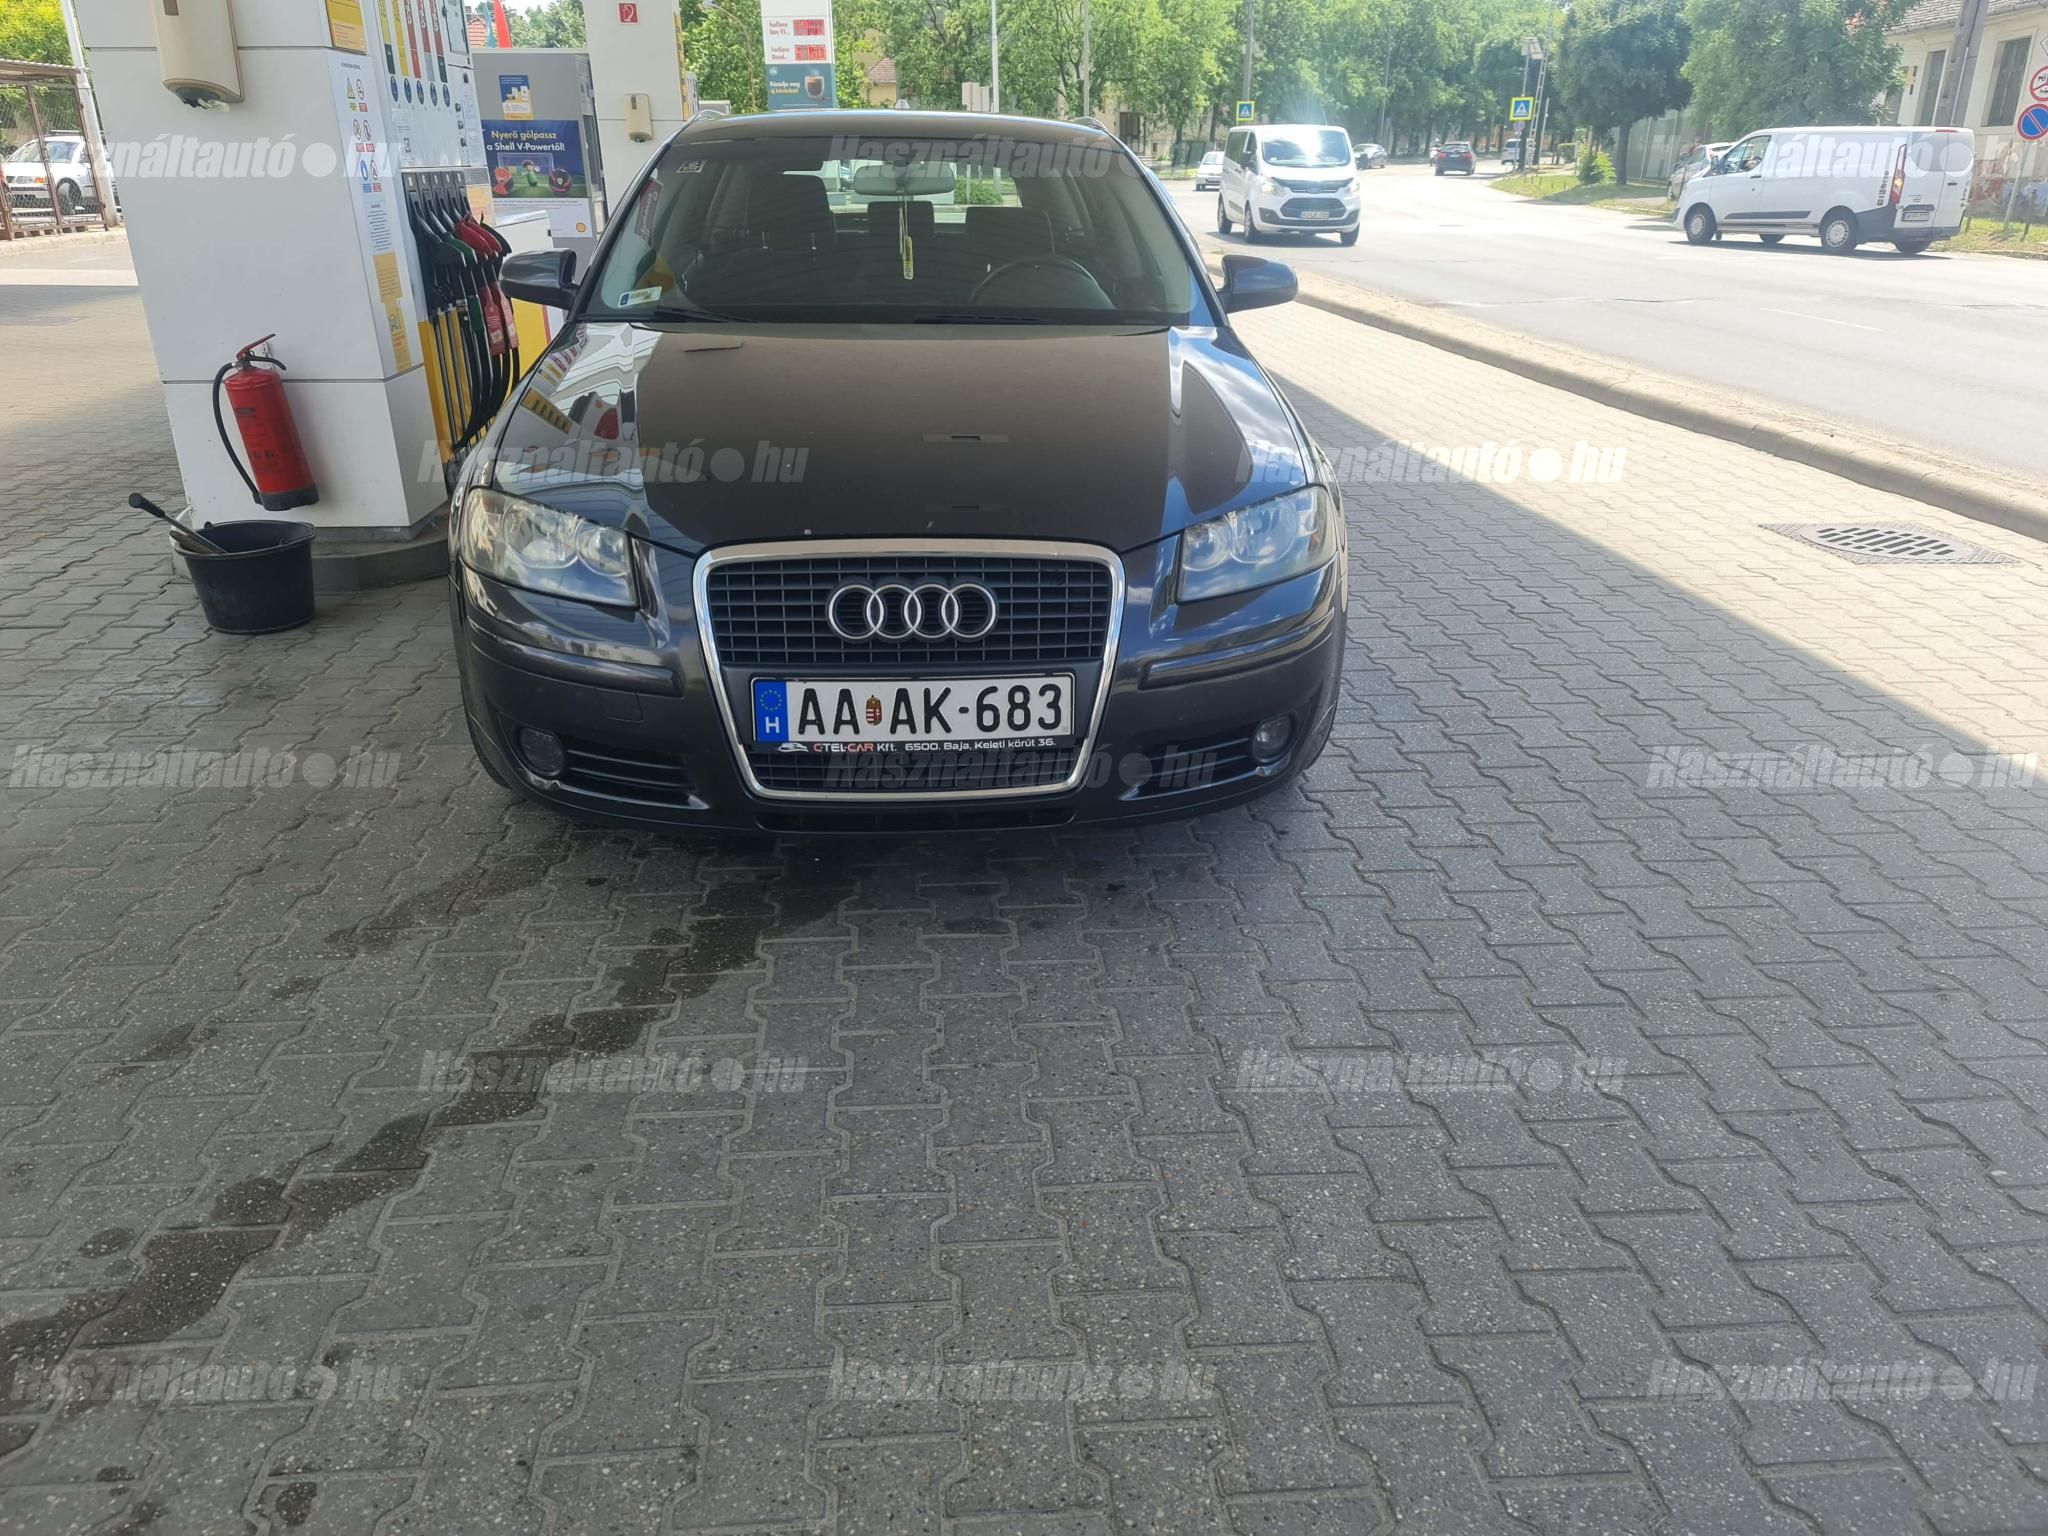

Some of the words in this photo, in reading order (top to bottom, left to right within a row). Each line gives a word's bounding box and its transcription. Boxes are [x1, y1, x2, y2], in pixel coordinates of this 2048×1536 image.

[491, 130, 518, 140] Nyerő
[520, 130, 557, 141] gólpassz
[494, 141, 515, 151] Shell
[765, 716, 781, 735] H
[798, 687, 861, 736] AA
[889, 683, 1062, 735] AK-683
[876, 742, 898, 752] Kft.
[974, 740, 1006, 750] Keleti
[1008, 738, 1036, 748] körút
[1037, 737, 1057, 747] 36.
